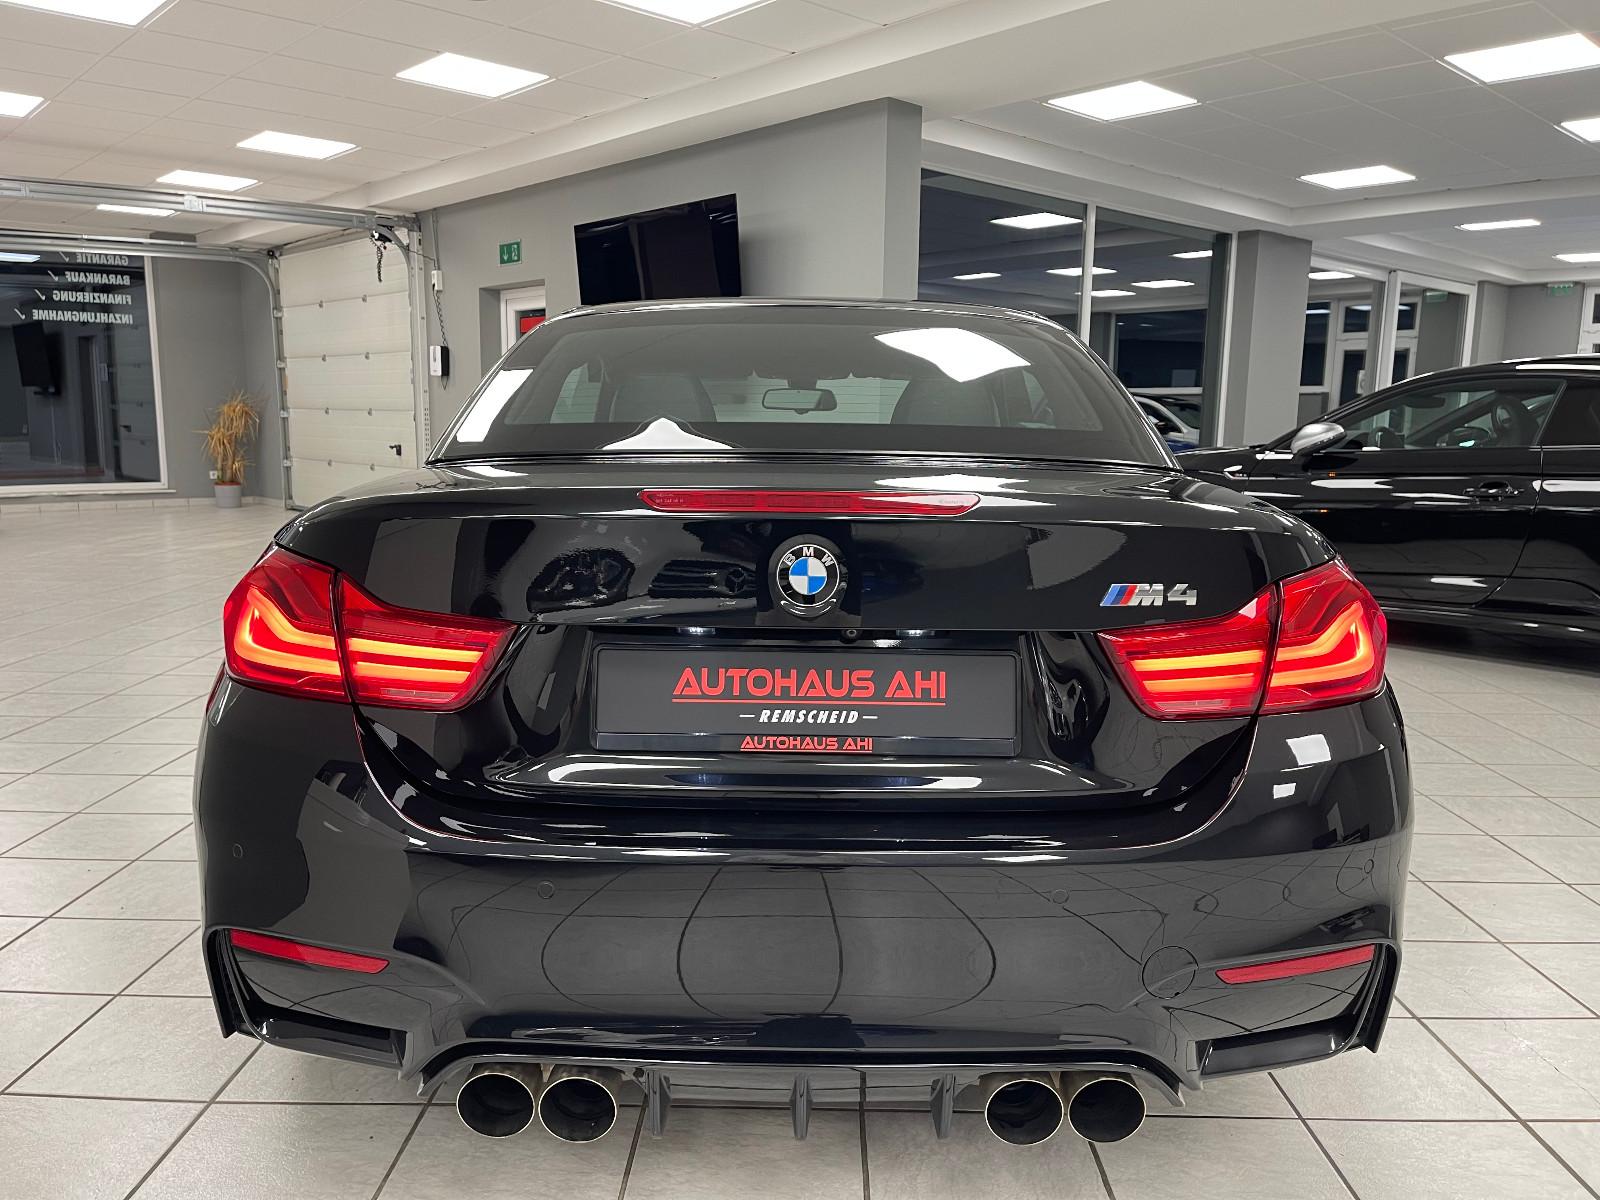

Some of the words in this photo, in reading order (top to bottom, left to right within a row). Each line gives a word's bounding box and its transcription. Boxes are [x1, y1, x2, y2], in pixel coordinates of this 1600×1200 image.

[783, 546, 835, 567] BMW
[1124, 583, 1198, 606] M4
[673, 667, 875, 698] AUTOHAUS
[884, 670, 946, 699] AHI
[759, 709, 859, 724] REMSCHEID
[740, 735, 838, 750] AUTOHAUS
[843, 737, 873, 751] AHI
